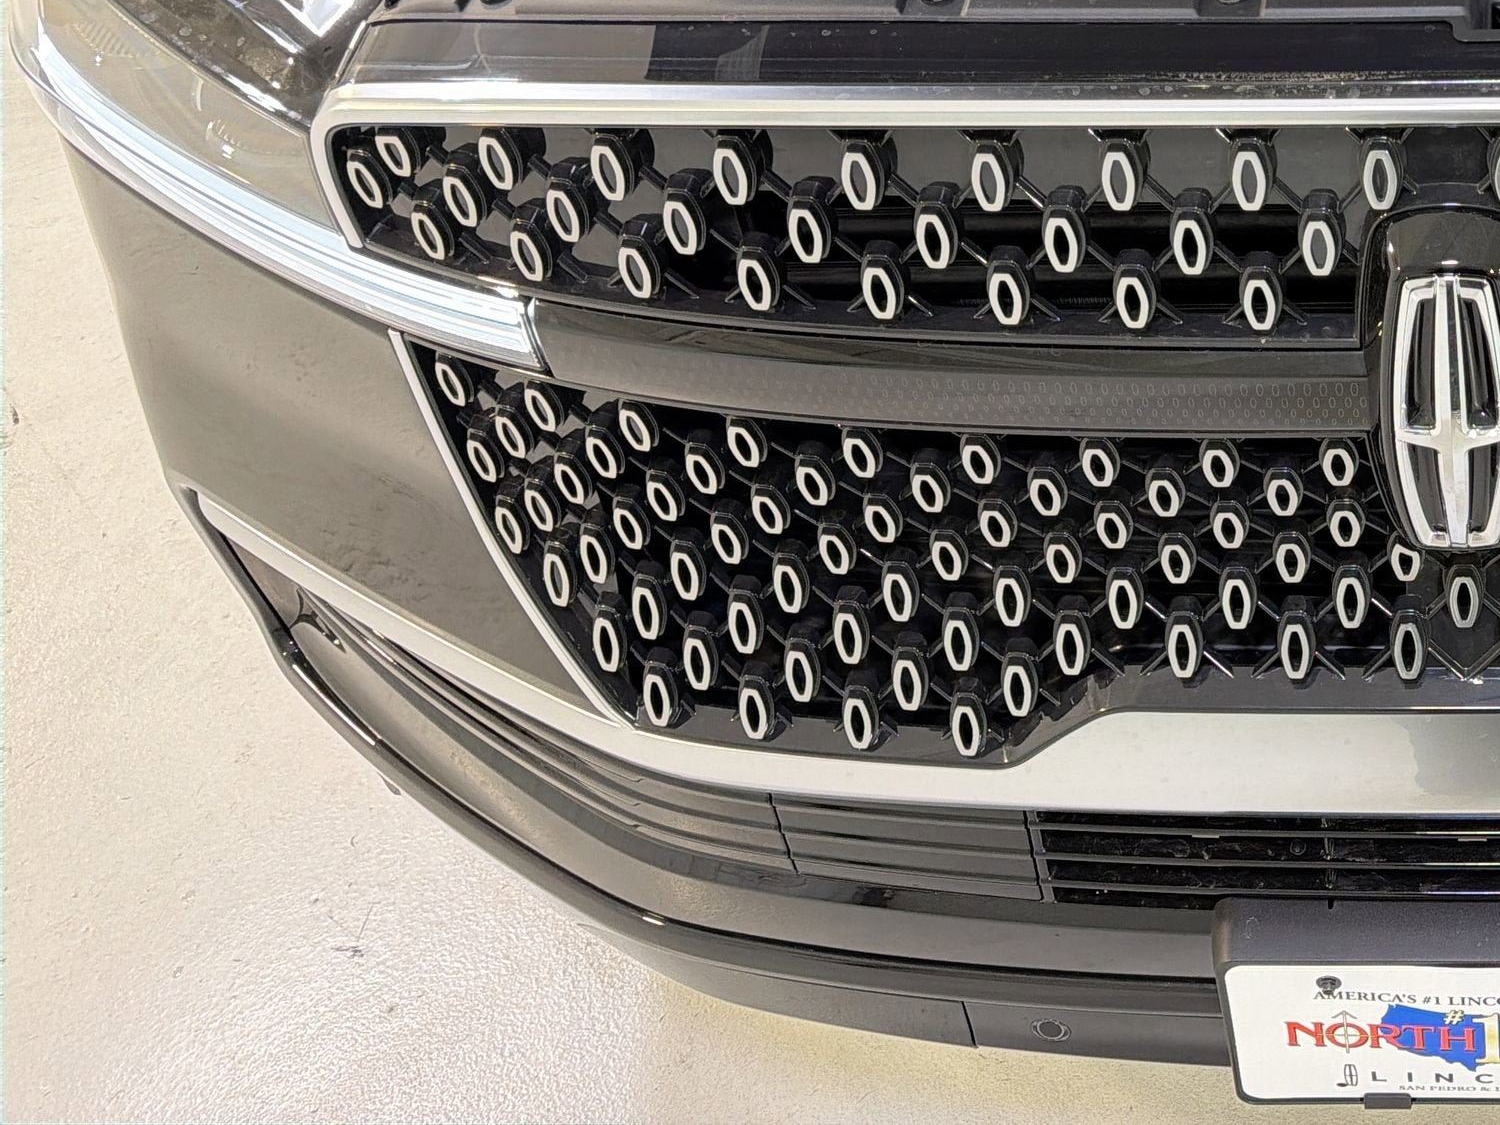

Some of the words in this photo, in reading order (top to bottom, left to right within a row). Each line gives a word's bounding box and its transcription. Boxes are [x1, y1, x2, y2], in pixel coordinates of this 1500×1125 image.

[1313, 990, 1417, 1004] AMERICA'S
[1422, 995, 1441, 1006] #1
[1284, 1021, 1477, 1052] NORTH
